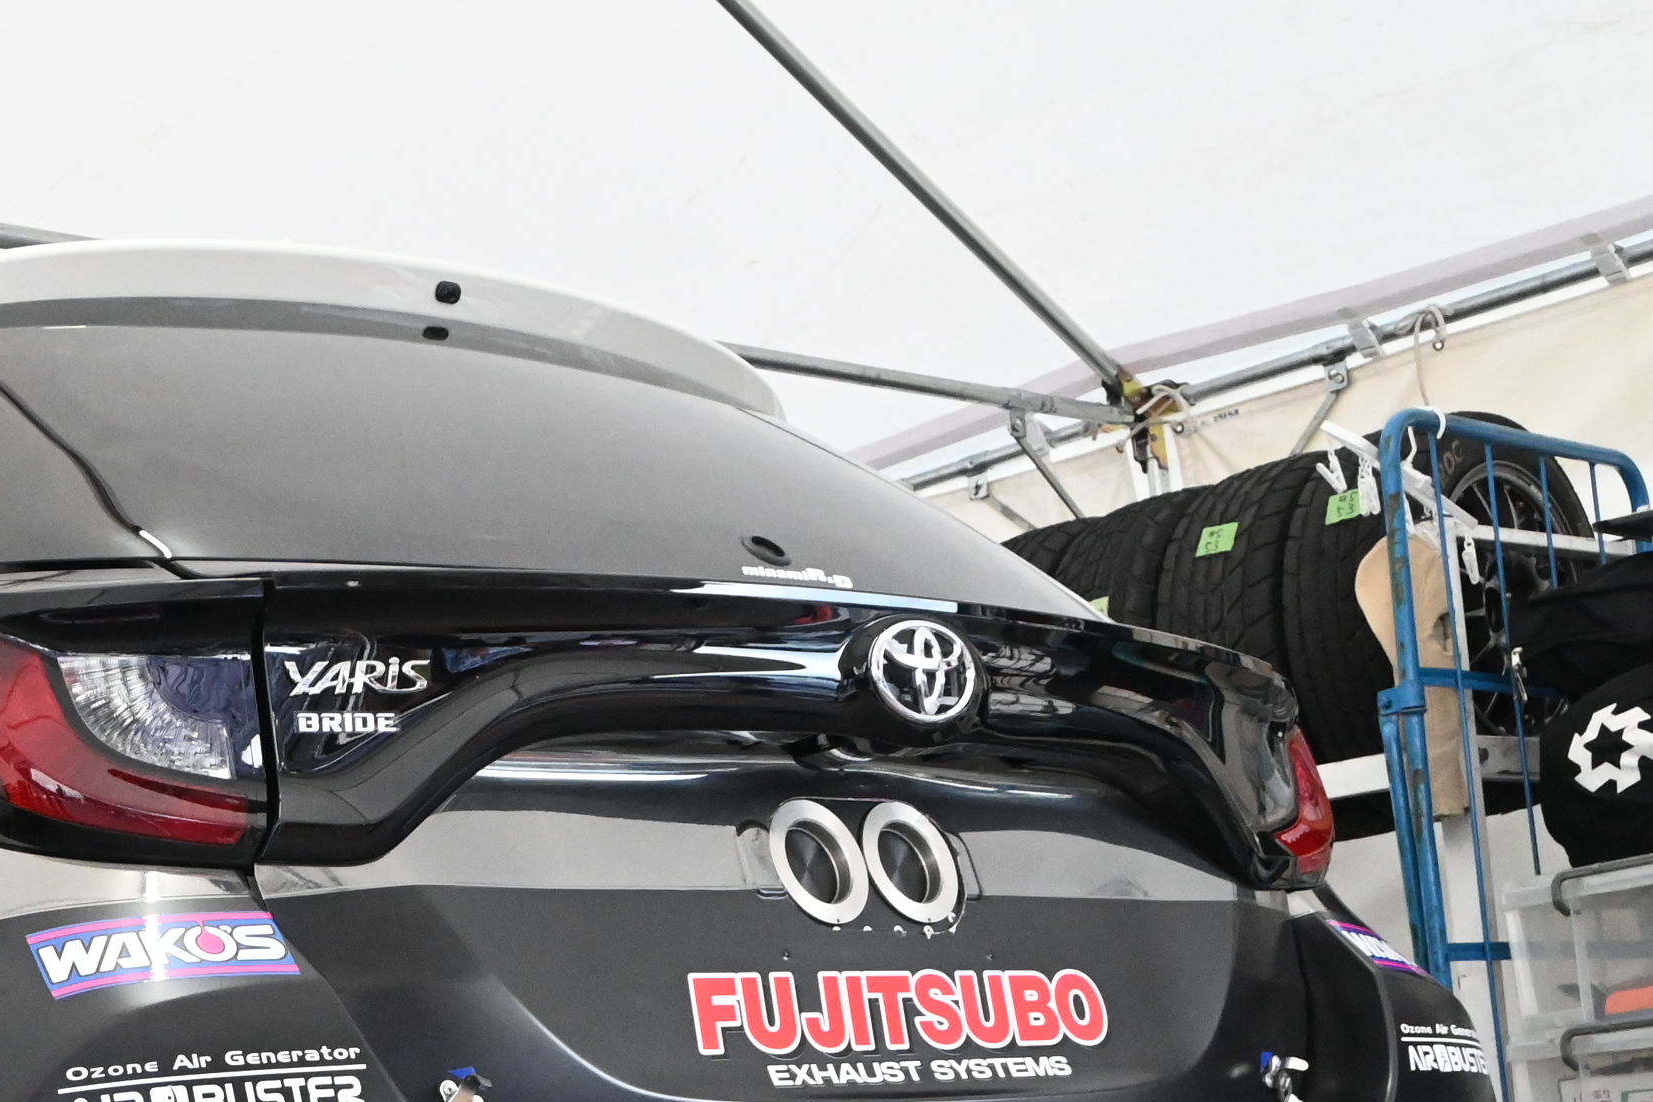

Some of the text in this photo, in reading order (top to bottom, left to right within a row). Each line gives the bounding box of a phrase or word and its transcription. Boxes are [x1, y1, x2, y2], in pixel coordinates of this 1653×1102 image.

[297, 712, 400, 733] BRIDE
[38, 923, 287, 985] WAKO'S
[687, 968, 1109, 1056] FUJITSUBO
[65, 1045, 361, 1081] Ozone Air Generator
[767, 1055, 1072, 1088] EXHAUST SYSTEMS
[1450, 1045, 1487, 1074] BUSTE
